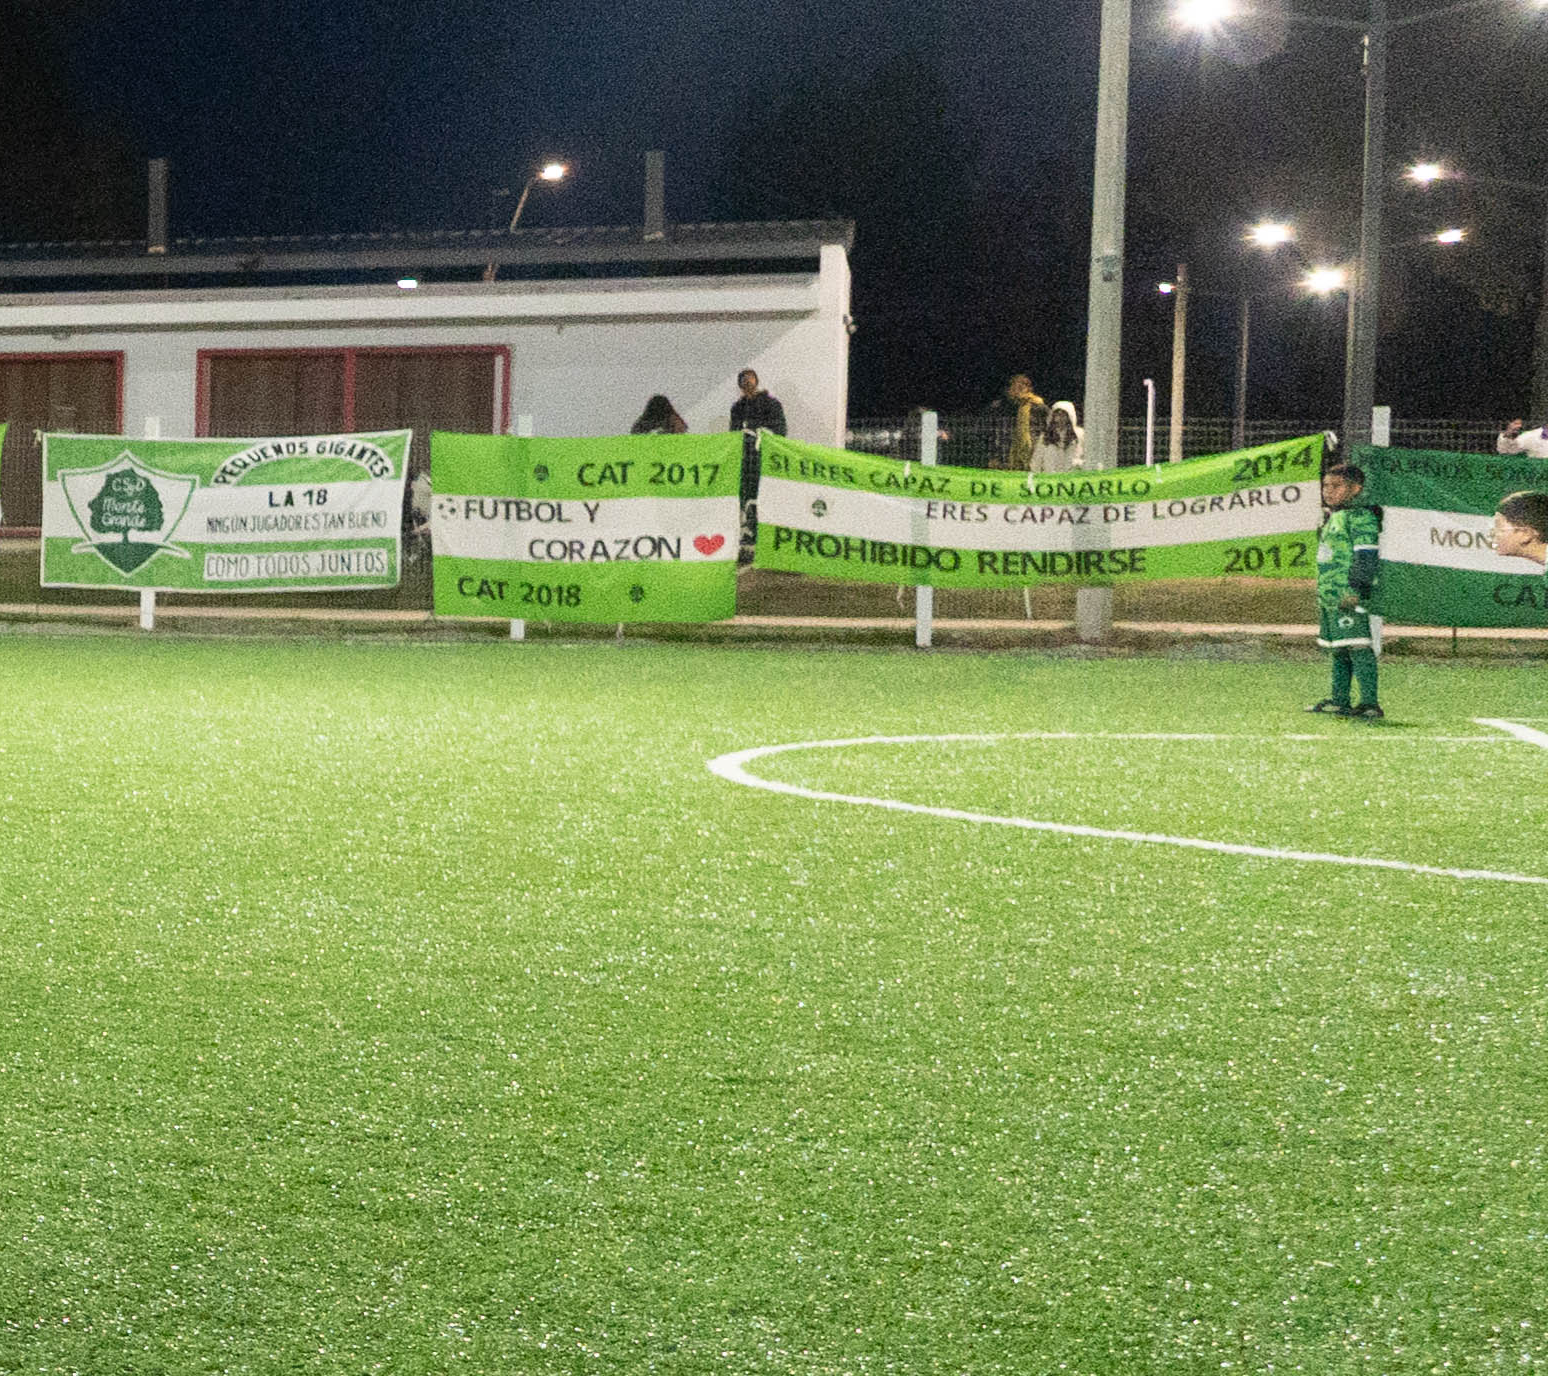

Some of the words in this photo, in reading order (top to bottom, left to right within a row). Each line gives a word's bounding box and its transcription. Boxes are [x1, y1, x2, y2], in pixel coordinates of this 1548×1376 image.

[316, 441, 389, 478] GIGANTES
[576, 461, 634, 487] CAT
[648, 462, 721, 487] 2017
[1232, 446, 1313, 482] 2014
[770, 453, 790, 473] SI
[800, 460, 854, 484] ERES
[869, 470, 952, 494] CAPAZ
[970, 480, 1002, 498] DE
[269, 490, 294, 508] LA
[303, 489, 328, 506] 18
[464, 500, 571, 524] FUTBOL
[583, 502, 600, 524] Y
[926, 501, 988, 522] ERES
[1003, 505, 1090, 524] CAPAZ
[1102, 504, 1137, 523] DE
[1152, 485, 1301, 521] LOGRARLO
[529, 535, 681, 561] CORAZON
[772, 526, 961, 572] PROHIBIDO
[977, 547, 1147, 575] RENDIRSE
[1224, 542, 1308, 573] 2012
[206, 555, 249, 578] COMO
[256, 554, 310, 575] TODOS
[316, 552, 385, 573] JUNTOS
[457, 576, 509, 601] CAT
[520, 582, 582, 607] 2018
